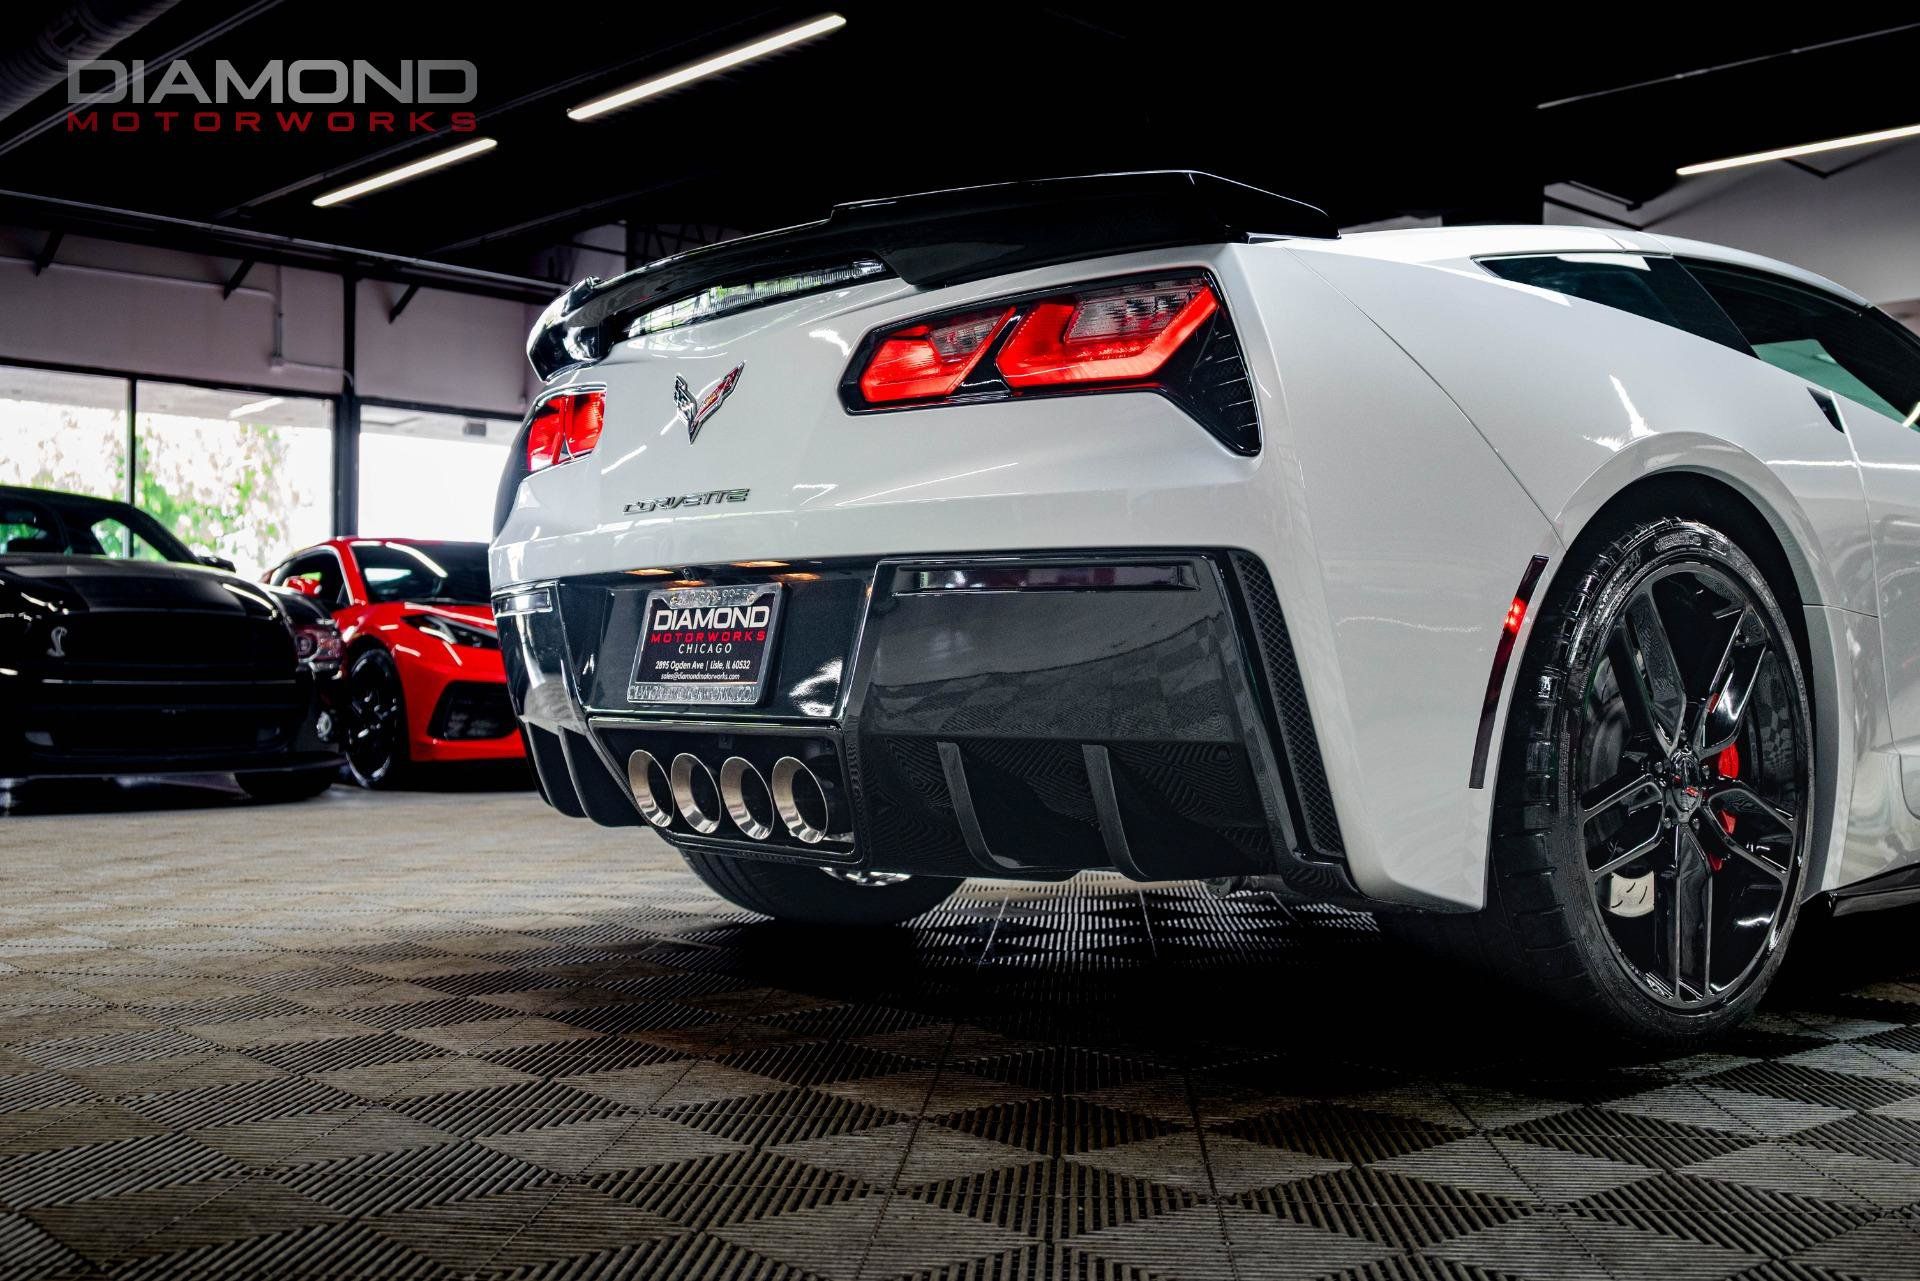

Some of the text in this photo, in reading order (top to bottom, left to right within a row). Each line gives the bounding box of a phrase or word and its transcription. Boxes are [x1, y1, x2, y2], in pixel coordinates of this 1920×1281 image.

[623, 488, 750, 514] CORVETTE
[653, 605, 770, 631] DIAMOND
[651, 630, 767, 644] MOTORWORKS
[678, 643, 732, 654] CHICAGO
[670, 660, 691, 671] Ogden
[691, 660, 704, 670] Ave
